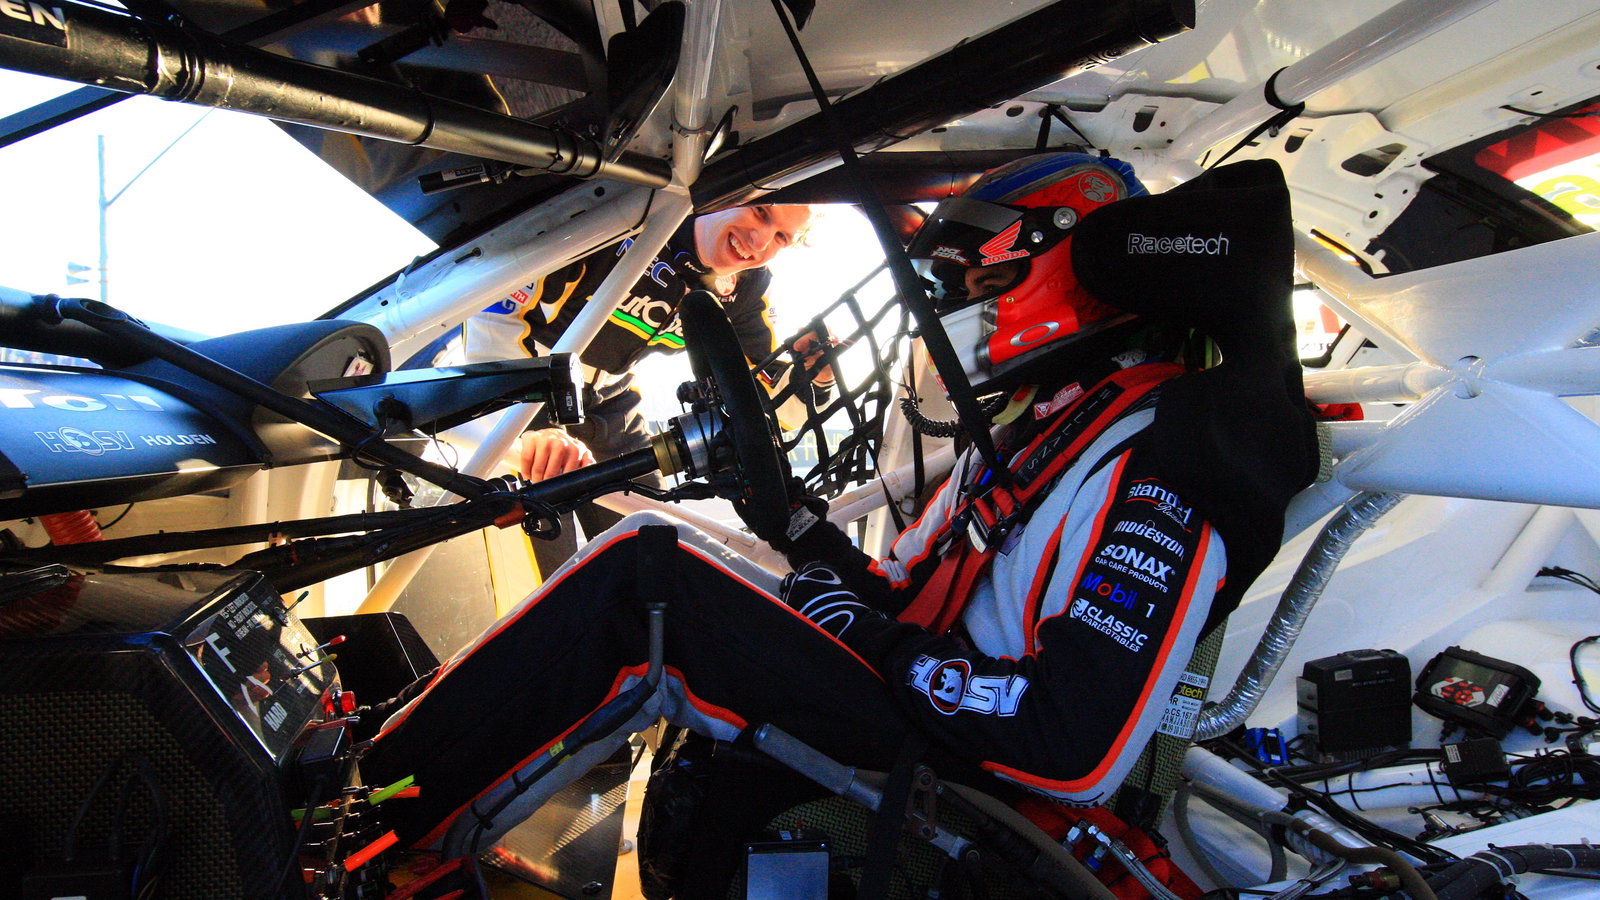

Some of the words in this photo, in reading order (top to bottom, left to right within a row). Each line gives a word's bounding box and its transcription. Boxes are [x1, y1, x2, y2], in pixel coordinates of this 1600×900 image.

[981, 249, 1030, 266] HONDA
[1127, 231, 1229, 255] Racetech
[139, 434, 217, 447] HOLDEN
[1094, 556, 1108, 566] CAR
[1108, 561, 1127, 574] CARE
[1128, 569, 1169, 593] PRODUCTS
[1100, 544, 1172, 582] SONAX
[1081, 572, 1138, 610] Mobil
[1145, 603, 1156, 619] 1
[1086, 606, 1149, 646] CLASSIC
[205, 632, 237, 674] F
[263, 701, 288, 732] HARD
